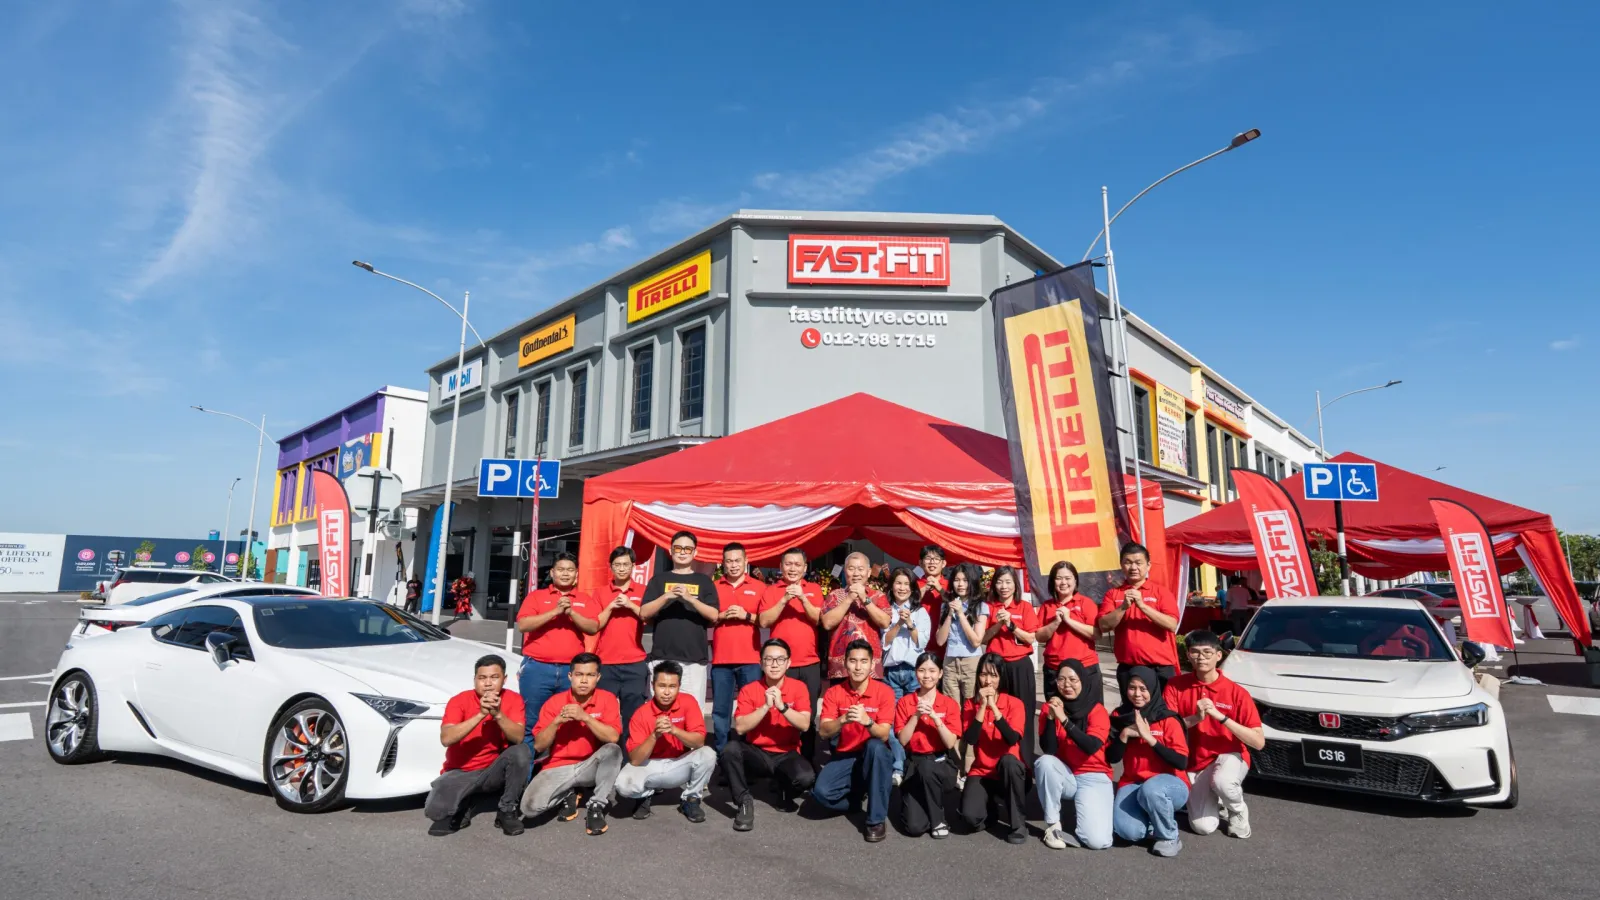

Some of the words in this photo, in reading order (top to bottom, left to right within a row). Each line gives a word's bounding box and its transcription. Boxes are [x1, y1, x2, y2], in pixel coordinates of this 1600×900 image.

[795, 245, 878, 273] FAST
[636, 264, 699, 312] PIRELLI
[788, 305, 948, 328] fastfittyre.com
[522, 327, 562, 358] Continental
[821, 331, 890, 346] 012-798
[894, 333, 936, 347] 7715
[1023, 329, 1102, 551] PIRELLI
[486, 463, 512, 492] P
[1311, 467, 1333, 494] P
[326, 551, 339, 597] FAST
[1467, 571, 1491, 613] FAST
